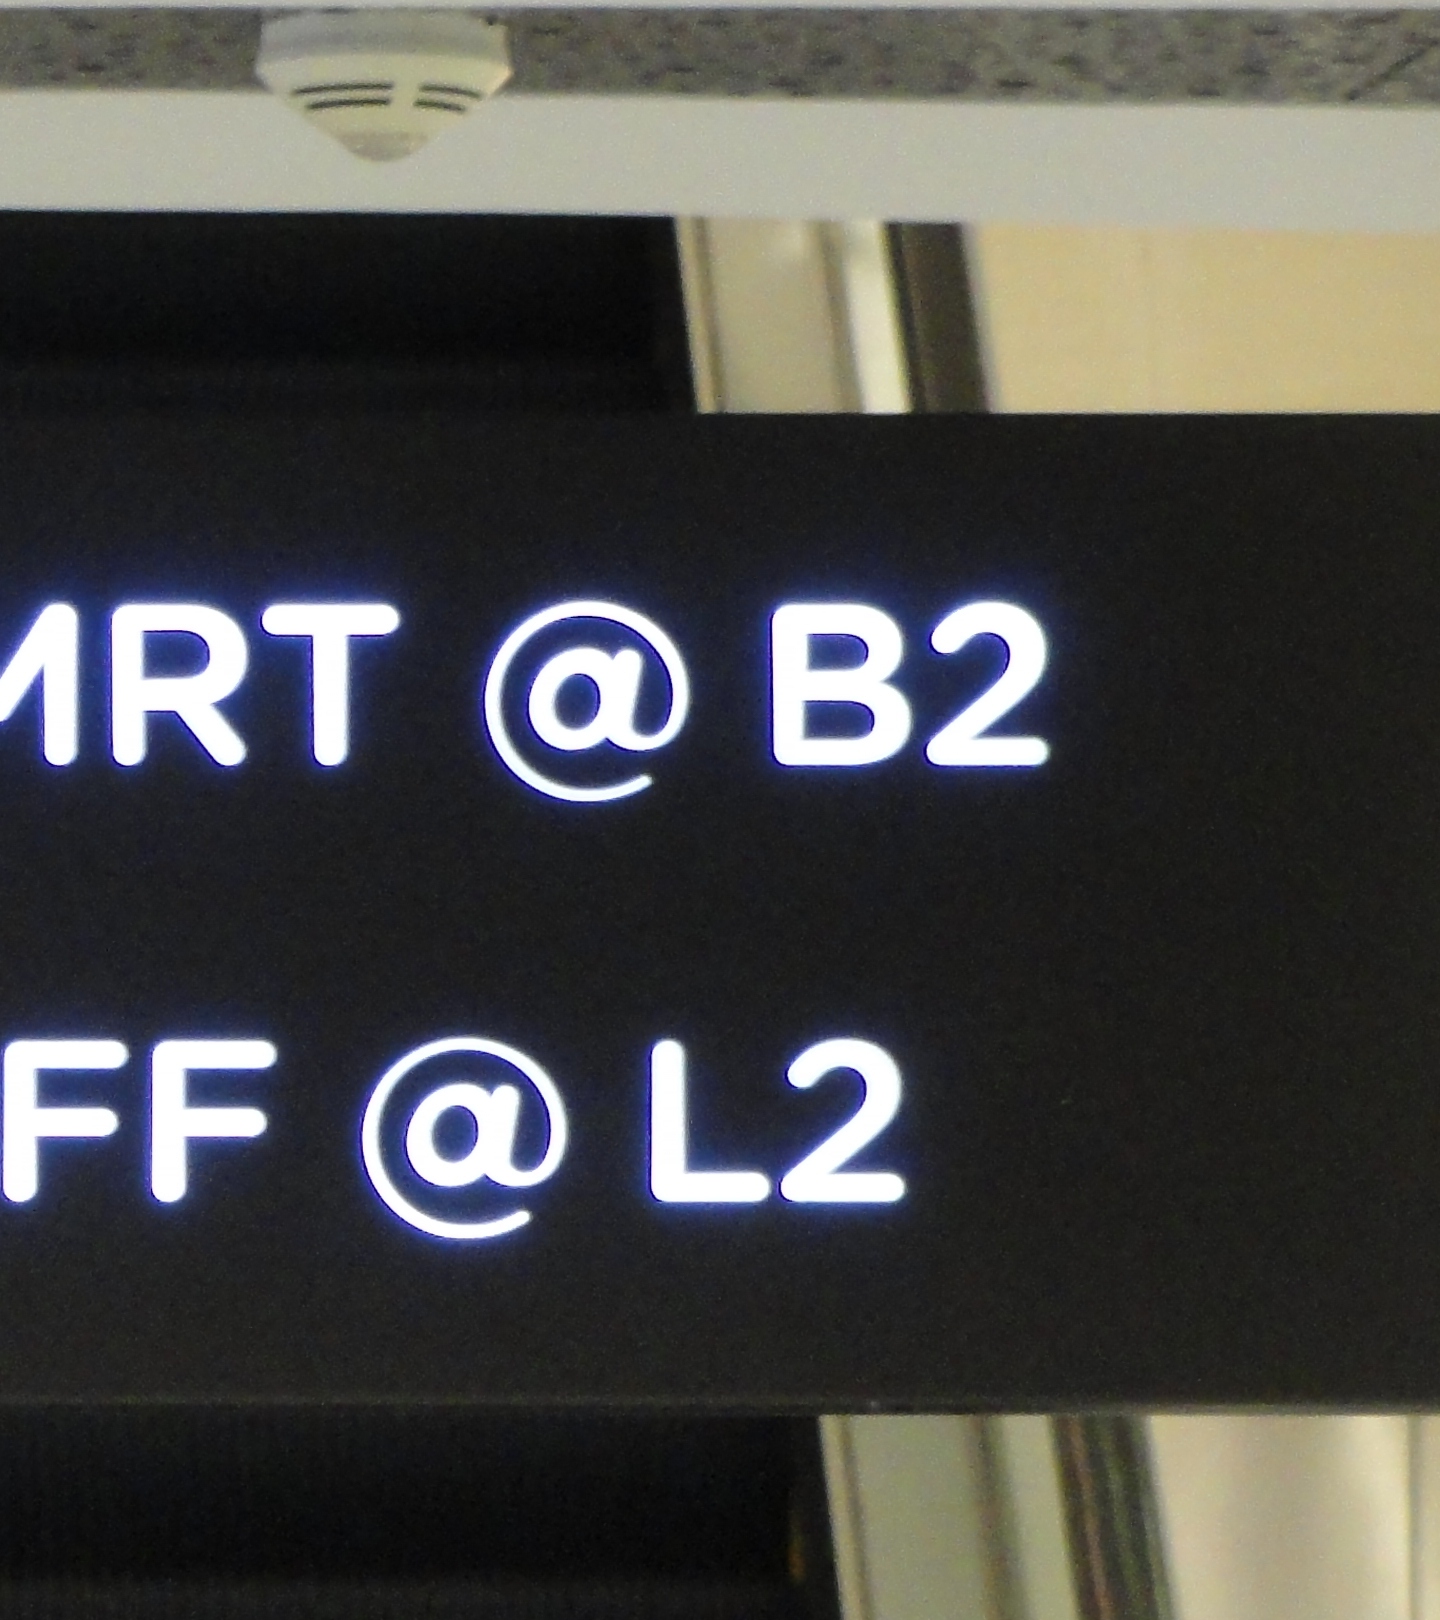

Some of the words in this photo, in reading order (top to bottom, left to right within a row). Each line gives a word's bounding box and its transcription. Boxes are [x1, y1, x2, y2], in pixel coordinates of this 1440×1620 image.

[483, 598, 691, 803] @
[769, 599, 1051, 768] B2
[360, 1035, 569, 1241] @
[649, 1036, 908, 1206] L2
